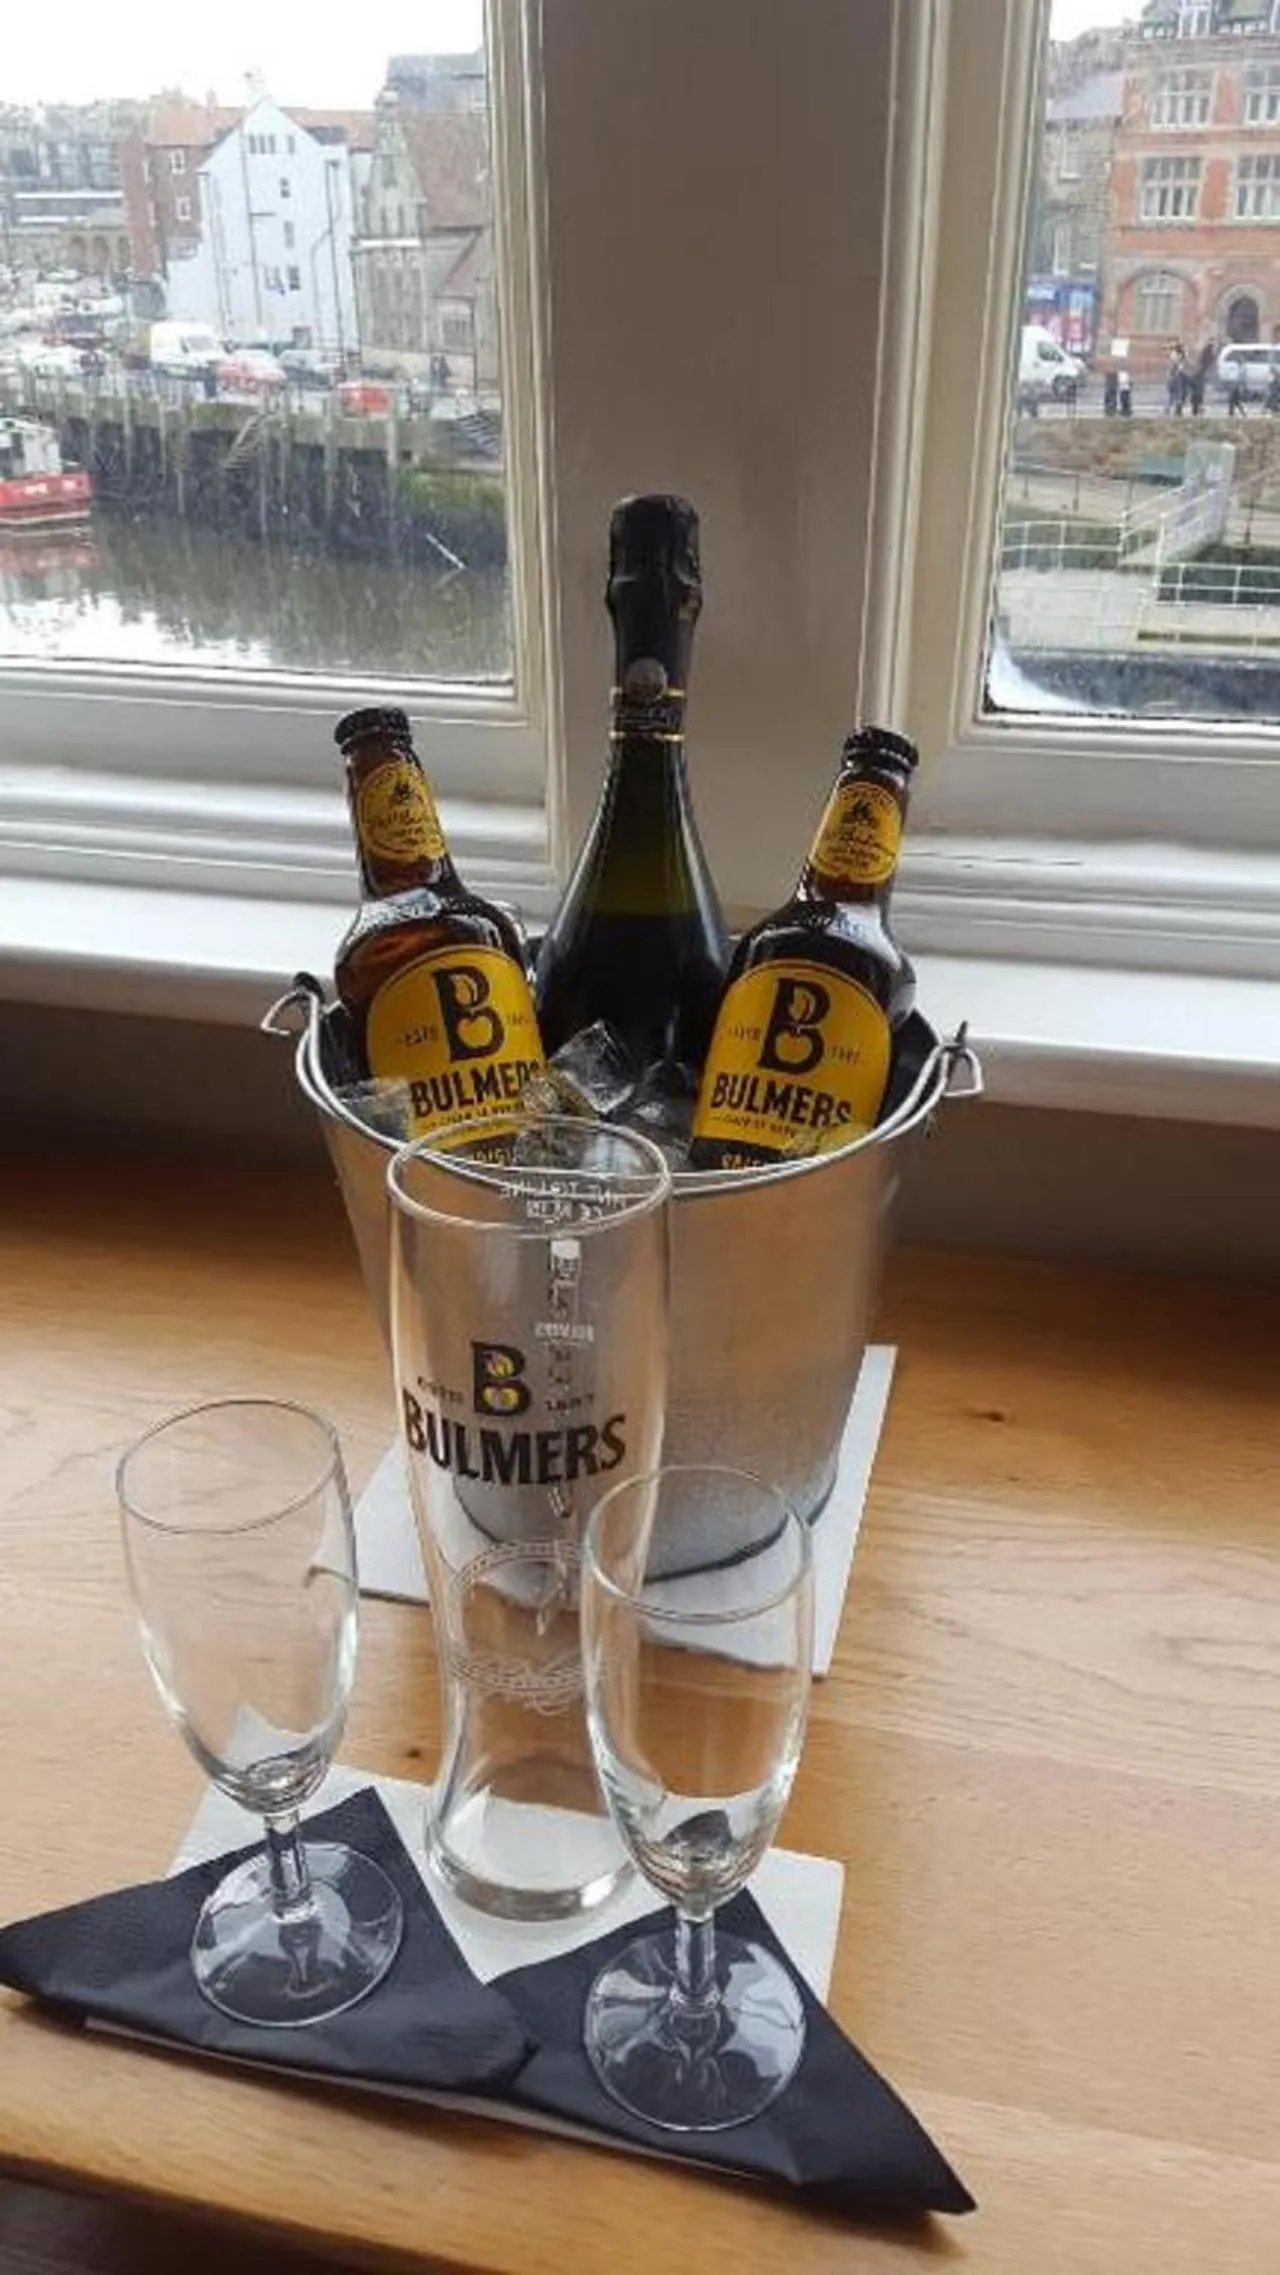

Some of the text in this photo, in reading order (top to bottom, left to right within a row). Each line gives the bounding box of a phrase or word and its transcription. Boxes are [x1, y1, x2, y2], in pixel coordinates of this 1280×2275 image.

[431, 965, 505, 1062] B
[757, 977, 830, 1075] B
[710, 1072, 852, 1129] BULMERS
[470, 1341, 532, 1417] B
[402, 1388, 628, 1486] BULMERS
